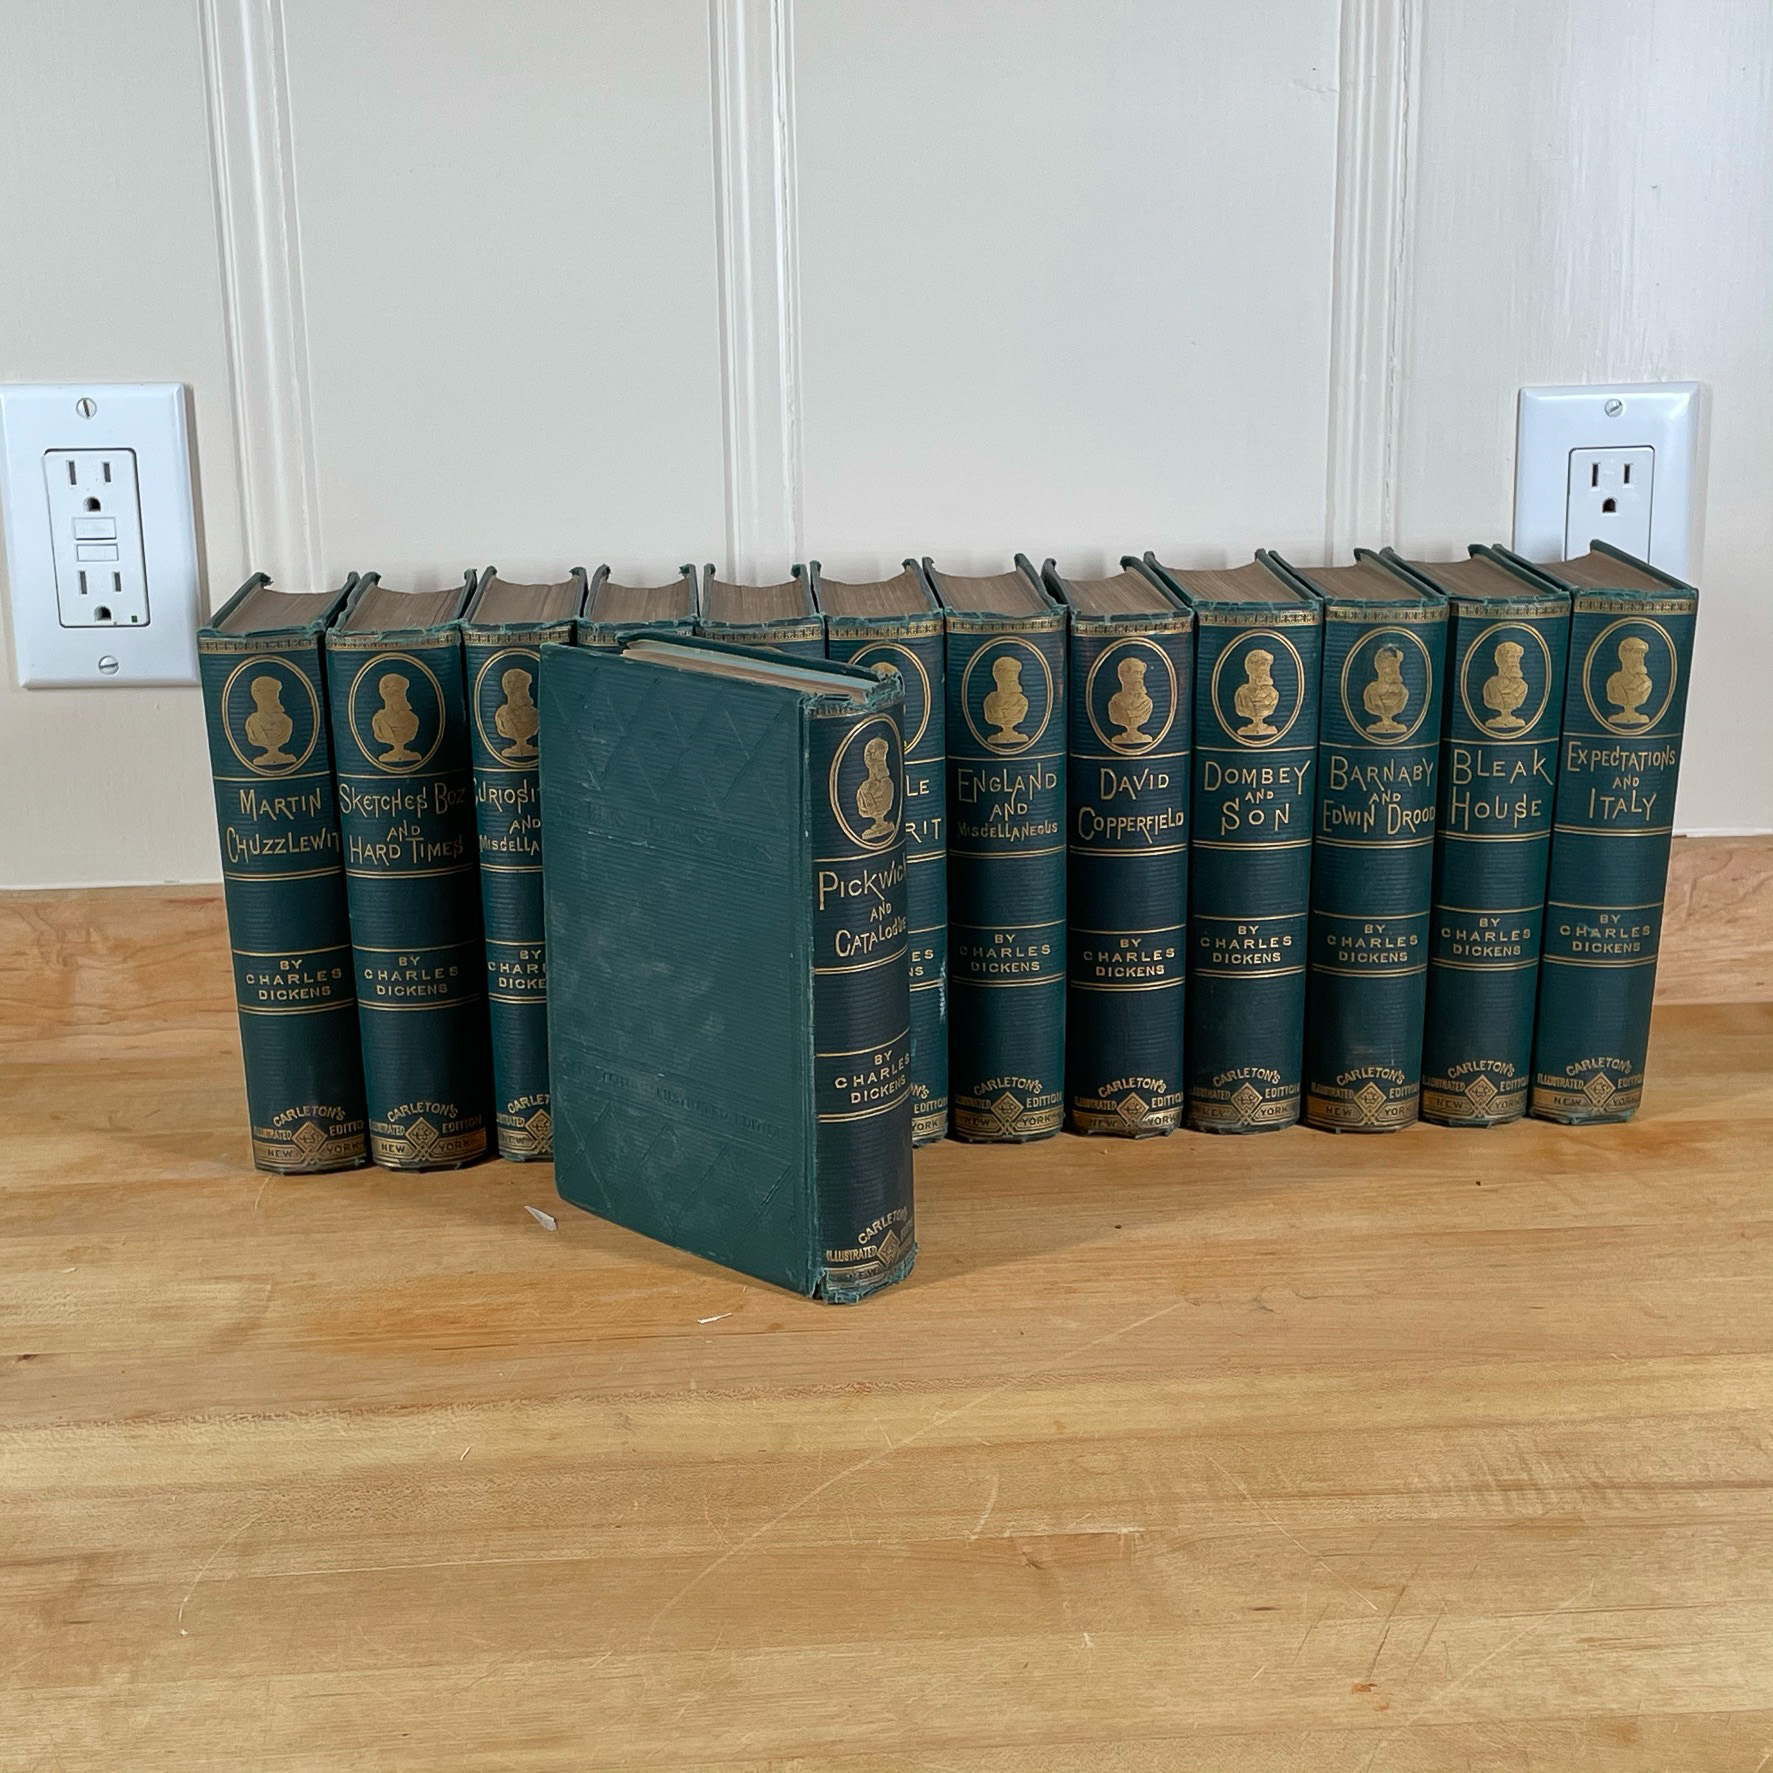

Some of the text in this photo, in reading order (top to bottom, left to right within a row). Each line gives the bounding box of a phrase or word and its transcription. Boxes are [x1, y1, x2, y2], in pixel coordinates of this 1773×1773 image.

[1567, 741, 1676, 772] EXPECTATIONS
[1330, 756, 1434, 791] BARNABY
[1453, 749, 1553, 785] BLEAK
[958, 762, 1057, 803] ENGLAND
[1100, 768, 1169, 800] DAVID
[1204, 760, 1311, 795] DOMBEY
[1612, 774, 1640, 790] AND
[340, 782, 466, 818] SKETCHES BOZ
[473, 777, 542, 814] URIOSI
[1245, 788, 1274, 803] AND
[1369, 789, 1401, 805] AND
[240, 788, 321, 821] MARTIN
[989, 803, 1028, 822] AND
[1451, 786, 1542, 831] HOUSE
[1589, 788, 1657, 821] ITALY
[509, 814, 541, 834] AND
[1221, 798, 1289, 836] SON
[1323, 799, 1435, 835] EDWIN DROOD
[386, 820, 421, 842] AND
[958, 820, 1058, 842] MISCELLANEOUS
[1078, 807, 1184, 844] COPPERFIELD
[349, 834, 463, 866] HARD TIMES
[870, 901, 892, 922] AND
[1600, 914, 1621, 924] BY
[1238, 926, 1259, 935] BY
[1364, 924, 1386, 934] BY
[1479, 918, 1500, 928] BY
[835, 916, 907, 957] CATALOGUE
[994, 934, 1016, 944] BY
[1441, 928, 1531, 942] CHARLES
[1560, 925, 1650, 939] CHARLES
[1120, 938, 1142, 948] BY
[1200, 936, 1292, 950] CHARLES
[1327, 935, 1418, 948] CHARLES
[1572, 940, 1641, 953] DICKENS
[520, 950, 542, 960] BY
[960, 944, 1051, 958] CHARLES
[1083, 948, 1175, 962] CHARLES
[1338, 951, 1408, 963] DICKENS
[1453, 944, 1521, 956] DICKENS
[280, 959, 302, 971] BY
[399, 956, 420, 967] BY
[1213, 952, 1281, 965] DICKENS
[364, 967, 458, 981] CHARLES
[488, 961, 546, 974] CHAR
[971, 961, 1041, 973] DICKENS
[1096, 965, 1165, 977] DICKENS
[246, 968, 342, 985] CHARLES
[258, 986, 331, 1000] DICKENS
[377, 984, 447, 996] DICKENS
[874, 1050, 893, 1066] BY
[834, 1053, 910, 1089] CHARLES
[1448, 1060, 1515, 1079] CARLETON'S
[1566, 1057, 1633, 1076] CARLETON'S
[1213, 1067, 1281, 1087] CARLETON'S
[1336, 1067, 1405, 1086] CARLETON'S
[851, 1077, 906, 1103] DICKENS
[974, 1076, 1043, 1096] CARLETON'S
[1098, 1077, 1167, 1098] CARLETON'S
[1260, 1107, 1288, 1116] YORK
[1326, 1106, 1353, 1116] NEW
[1437, 1099, 1463, 1108] NEW
[273, 1105, 346, 1127] CARLETON'S
[387, 1102, 459, 1122] CARLETON'S
[965, 1116, 1051, 1126] NEW YORK
[268, 1143, 359, 1158] NEW YORK
[381, 1141, 469, 1153] NEW YORK
[826, 1245, 877, 1262] ILLUSTRATED
